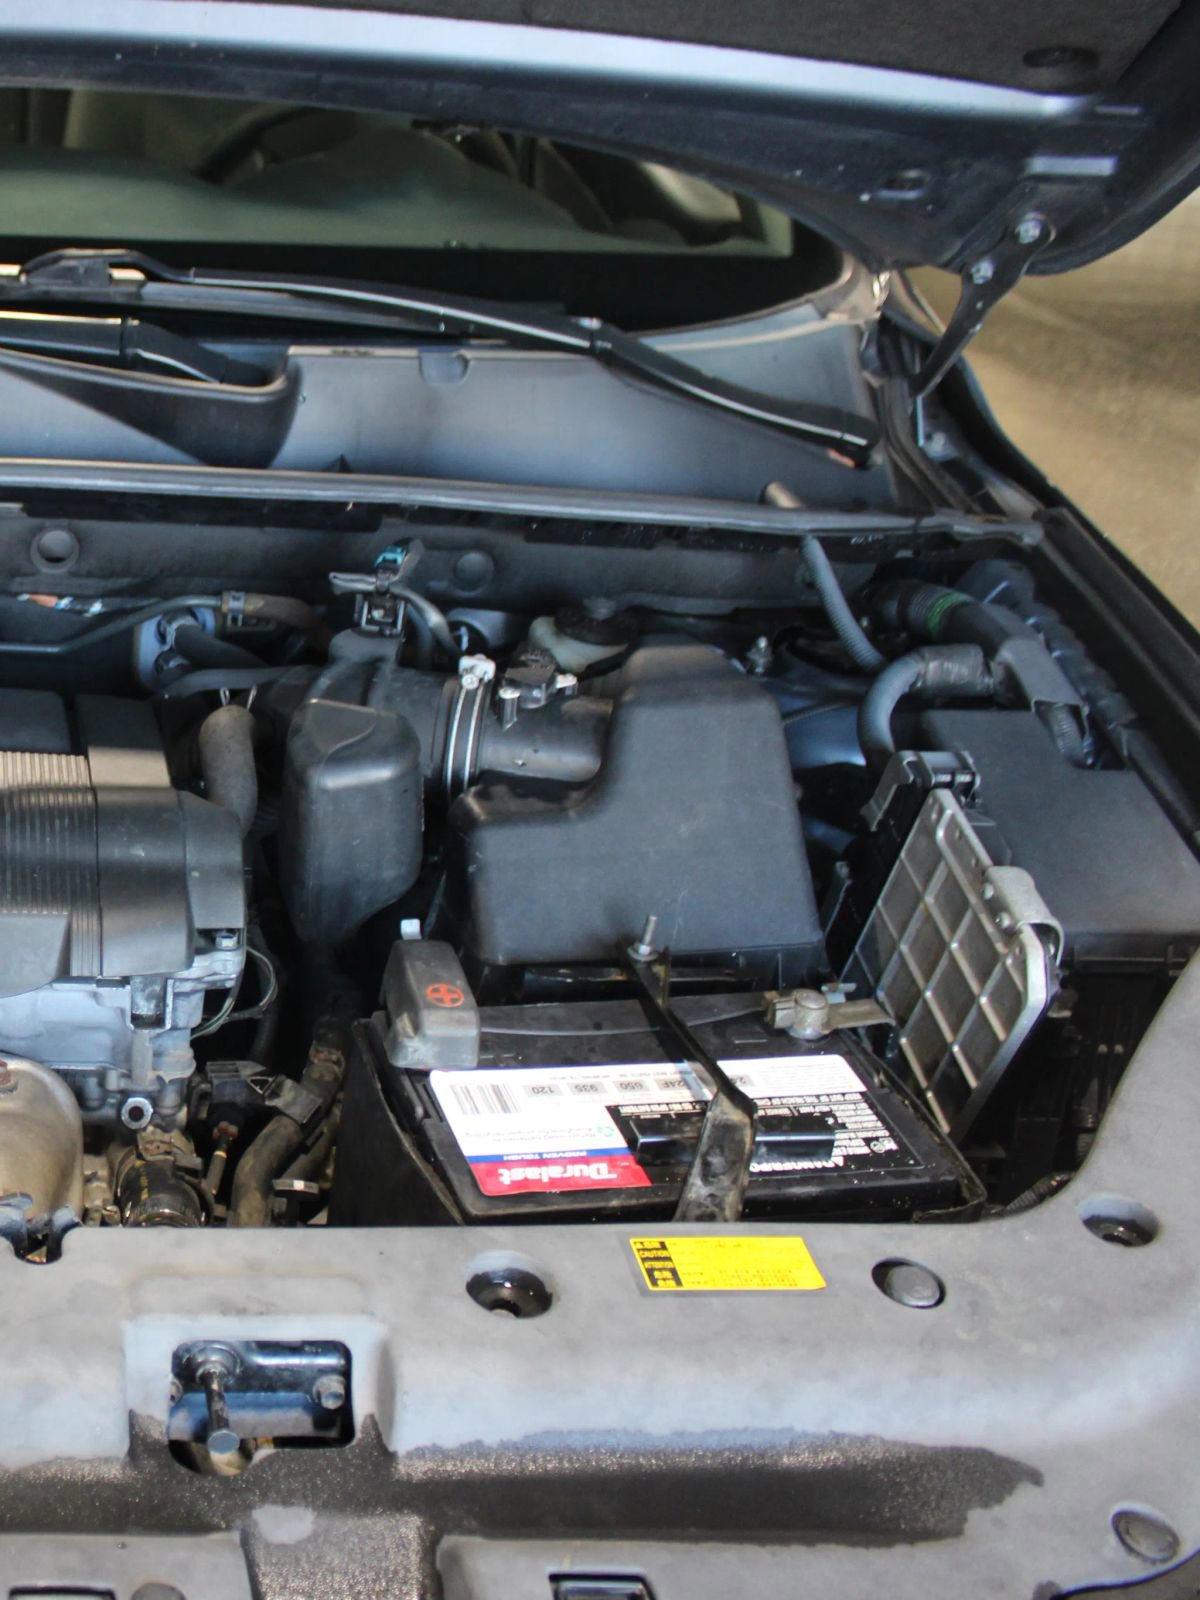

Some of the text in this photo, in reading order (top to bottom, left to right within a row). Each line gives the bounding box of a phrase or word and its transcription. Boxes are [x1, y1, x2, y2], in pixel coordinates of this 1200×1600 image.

[530, 1086, 556, 1095] 120
[573, 1084, 600, 1093] 935
[543, 1150, 586, 1159] PROVEN
[498, 1162, 617, 1184] Duralast
